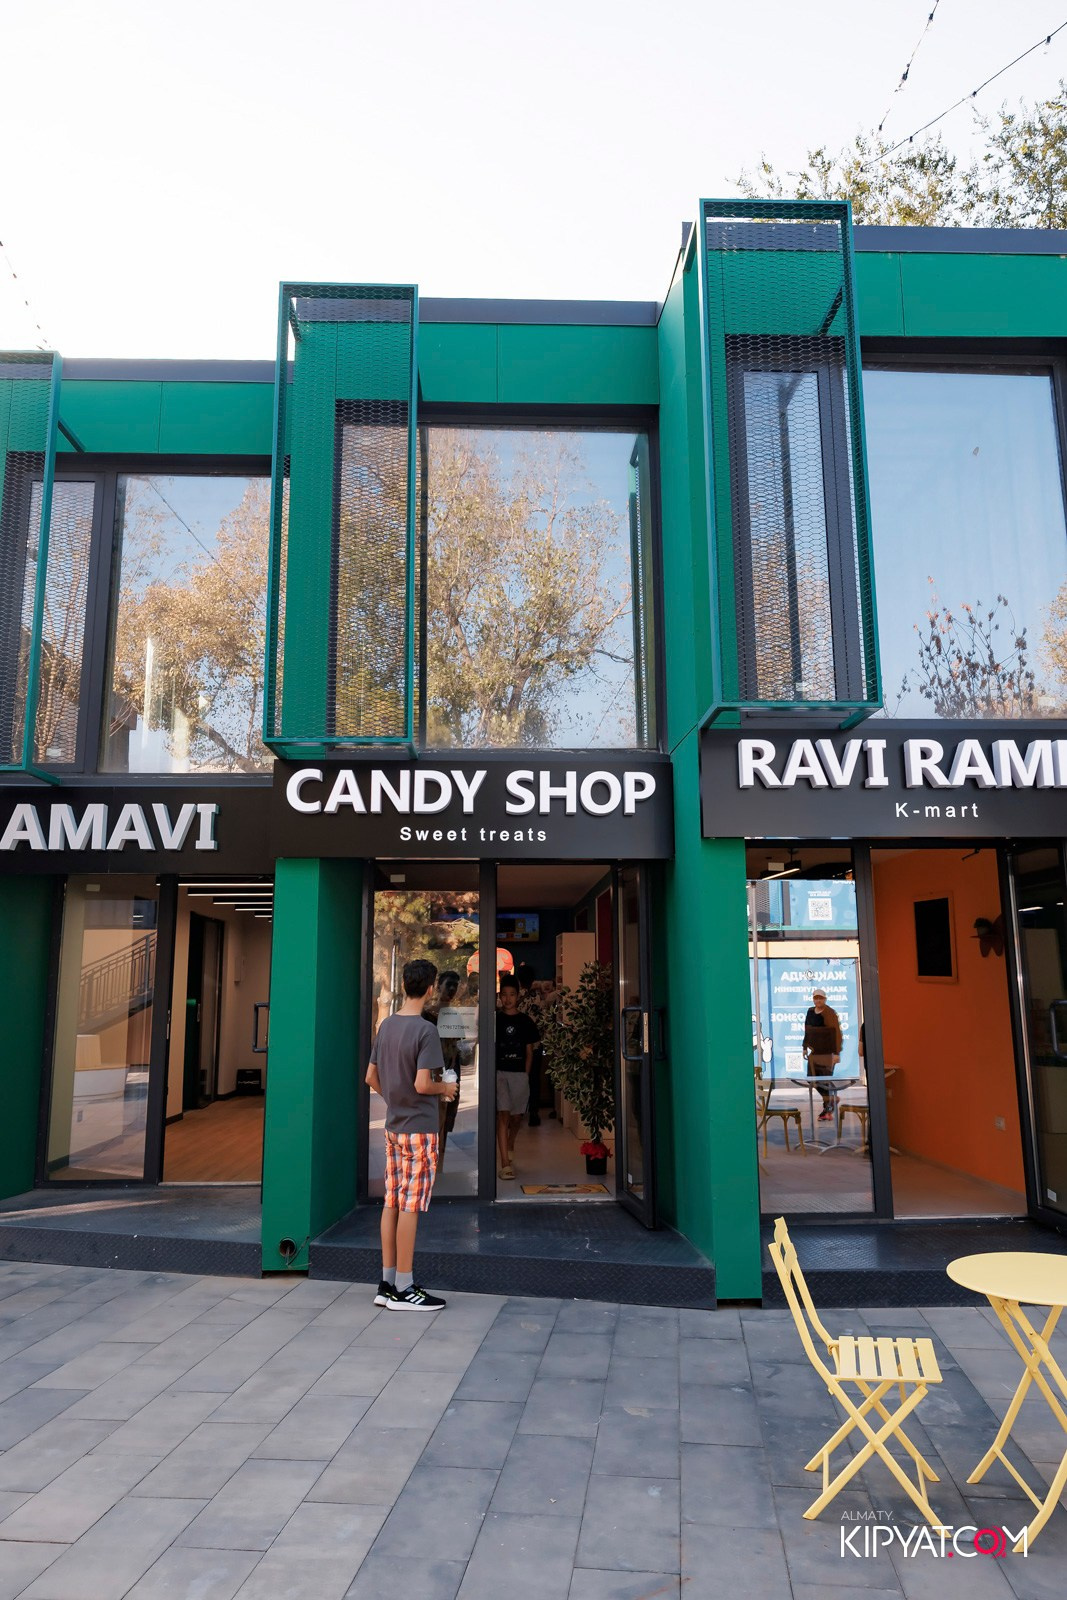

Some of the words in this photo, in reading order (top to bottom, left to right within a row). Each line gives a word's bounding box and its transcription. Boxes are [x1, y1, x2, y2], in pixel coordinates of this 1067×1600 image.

[738, 738, 890, 788] RAVI
[285, 768, 488, 816] CANDY
[505, 769, 656, 817] SHOP
[895, 802, 979, 818] K-mart
[0, 803, 220, 851] AMAVI
[400, 827, 467, 842] Sweet
[480, 827, 547, 842] treats
